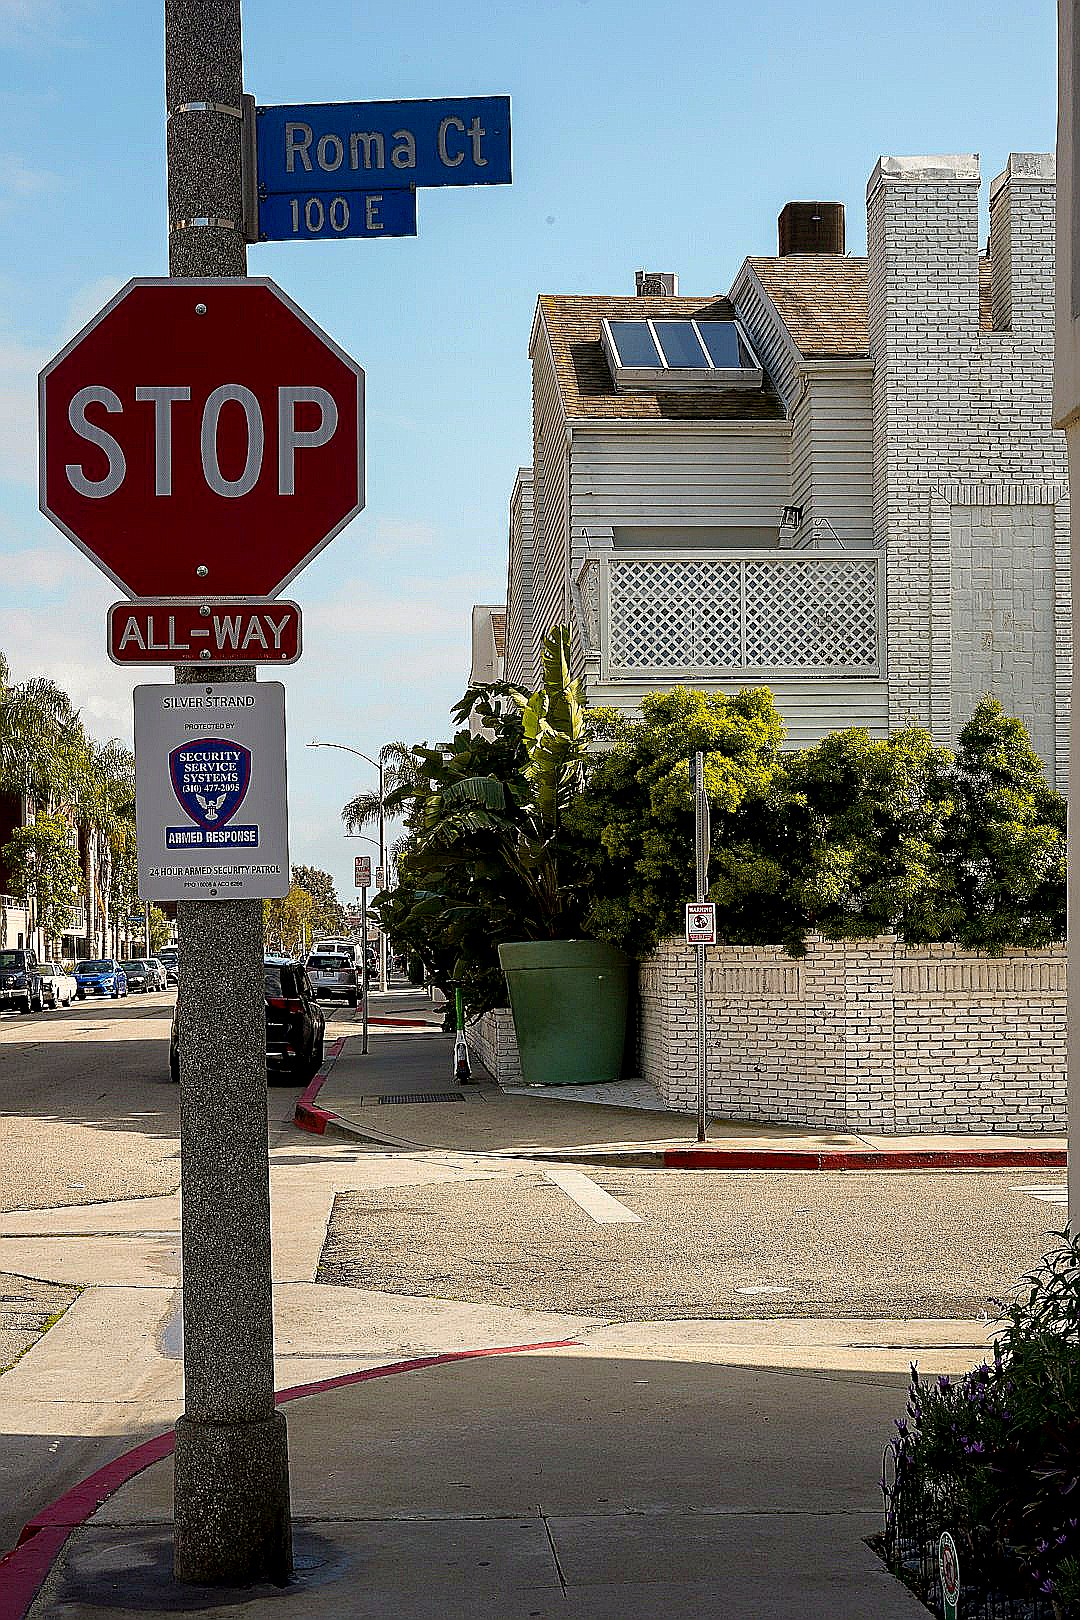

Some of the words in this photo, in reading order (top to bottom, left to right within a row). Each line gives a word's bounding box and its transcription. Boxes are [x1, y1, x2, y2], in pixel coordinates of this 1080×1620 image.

[285, 121, 417, 173] Roma
[437, 115, 489, 167] Ct
[289, 195, 350, 233] 100
[365, 194, 385, 230] E
[65, 383, 339, 499] STOP
[118, 615, 291, 650] ALL-WAY
[163, 697, 203, 709] SILVER
[206, 696, 255, 708] STRAND
[184, 723, 224, 731] PROTECTED
[179, 751, 241, 762] SECURITY
[184, 762, 237, 772] SERVICE
[183, 773, 238, 783] SYSTEMS
[182, 784, 202, 793] (310)
[168, 831, 203, 844] ARMED
[205, 830, 256, 843] RESPONSE
[149, 868, 160, 877] 24
[160, 867, 183, 876] HOUR
[184, 867, 212, 876] ARMED
[213, 866, 250, 875] SECURITY
[251, 865, 281, 874] PATROL
